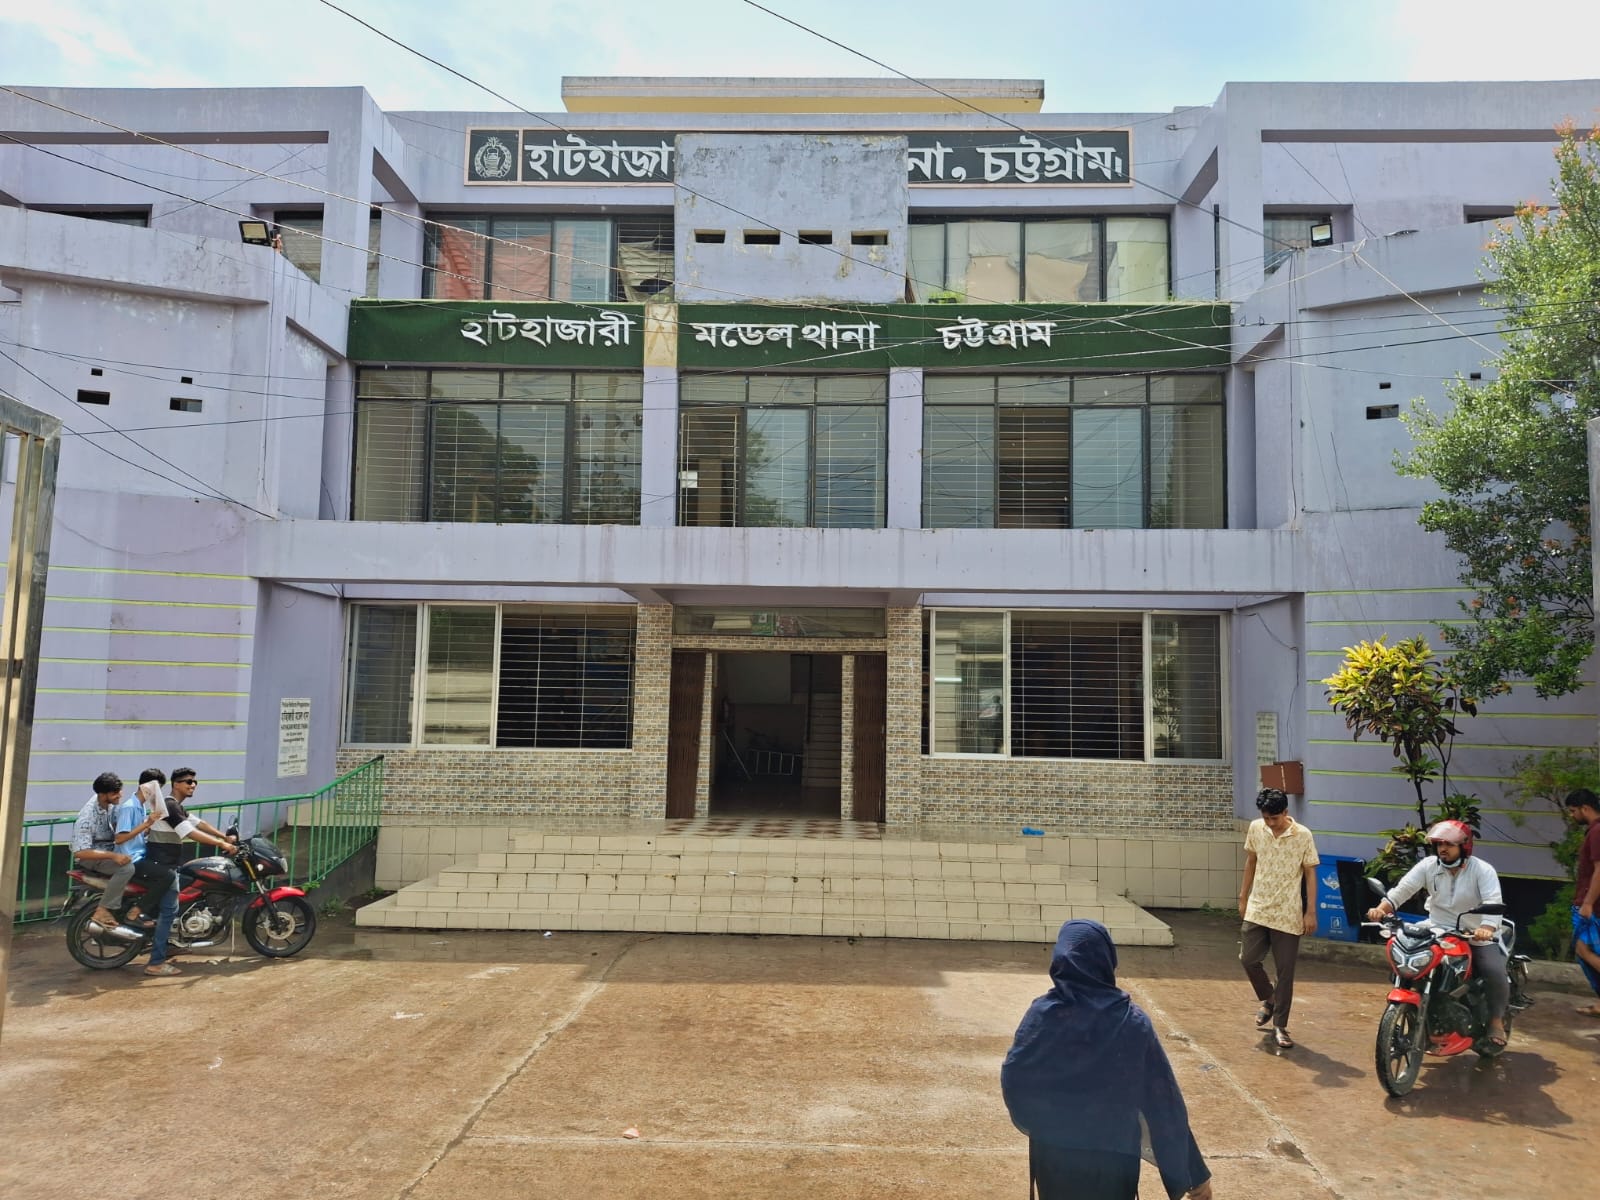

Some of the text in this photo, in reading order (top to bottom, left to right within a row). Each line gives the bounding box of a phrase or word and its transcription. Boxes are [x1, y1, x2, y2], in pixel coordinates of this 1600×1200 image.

[524, 134, 675, 179] হাটহাজা
[908, 141, 966, 183] না,
[461, 310, 1057, 350] হাটহাজারী মডেল থানা চট্টগ্রাম
